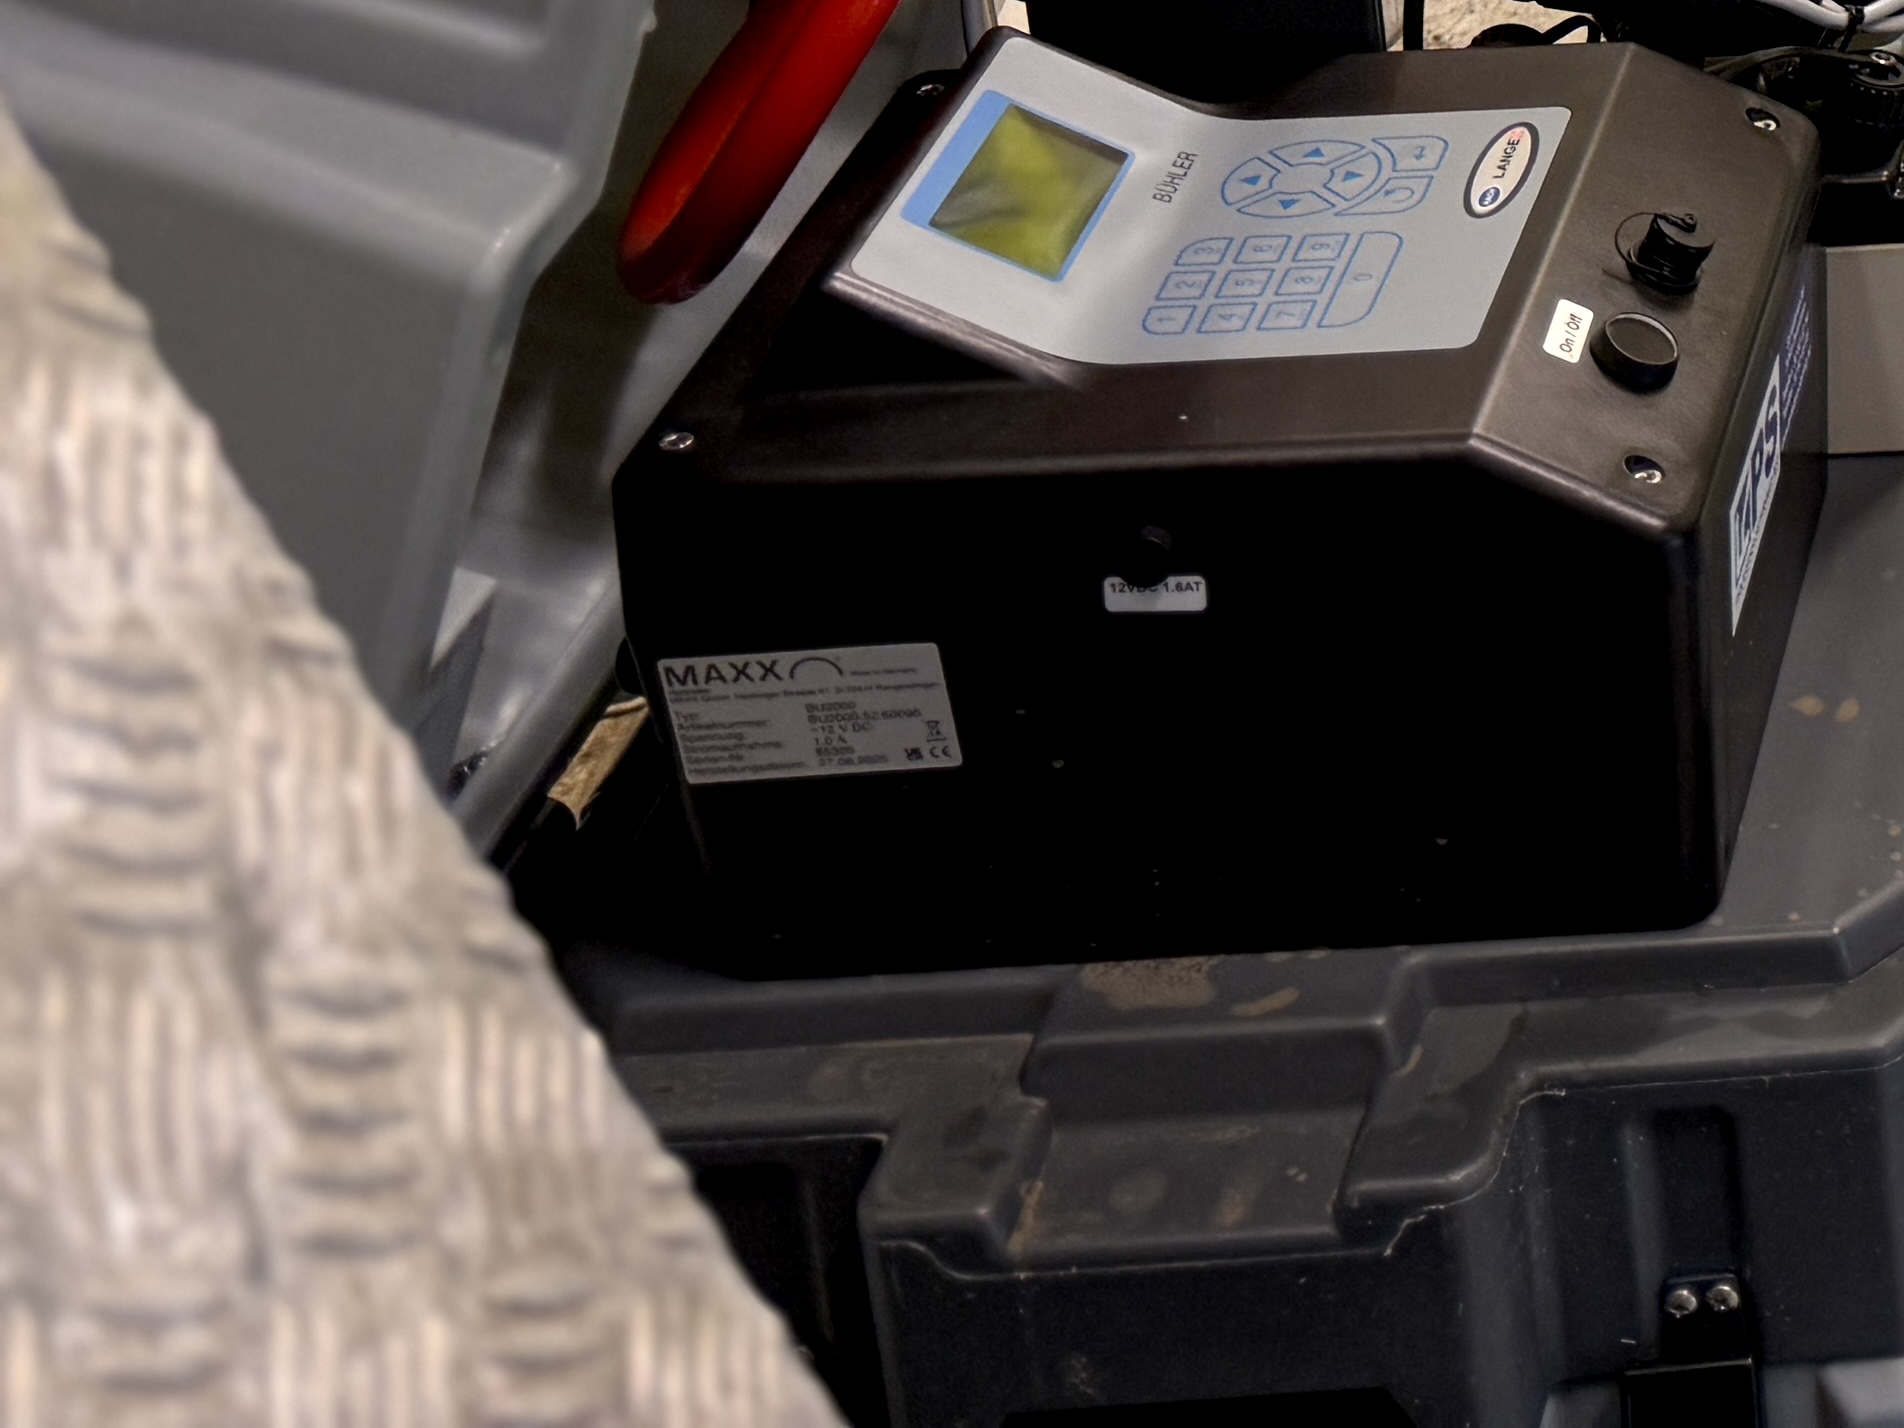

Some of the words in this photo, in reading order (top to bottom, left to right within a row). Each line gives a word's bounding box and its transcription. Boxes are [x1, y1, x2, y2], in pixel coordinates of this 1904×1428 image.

[1493, 138, 1521, 180] LANGE
[1152, 151, 1198, 203] BÜHLER
[1560, 338, 1574, 353] On
[662, 659, 783, 687] MAXX
